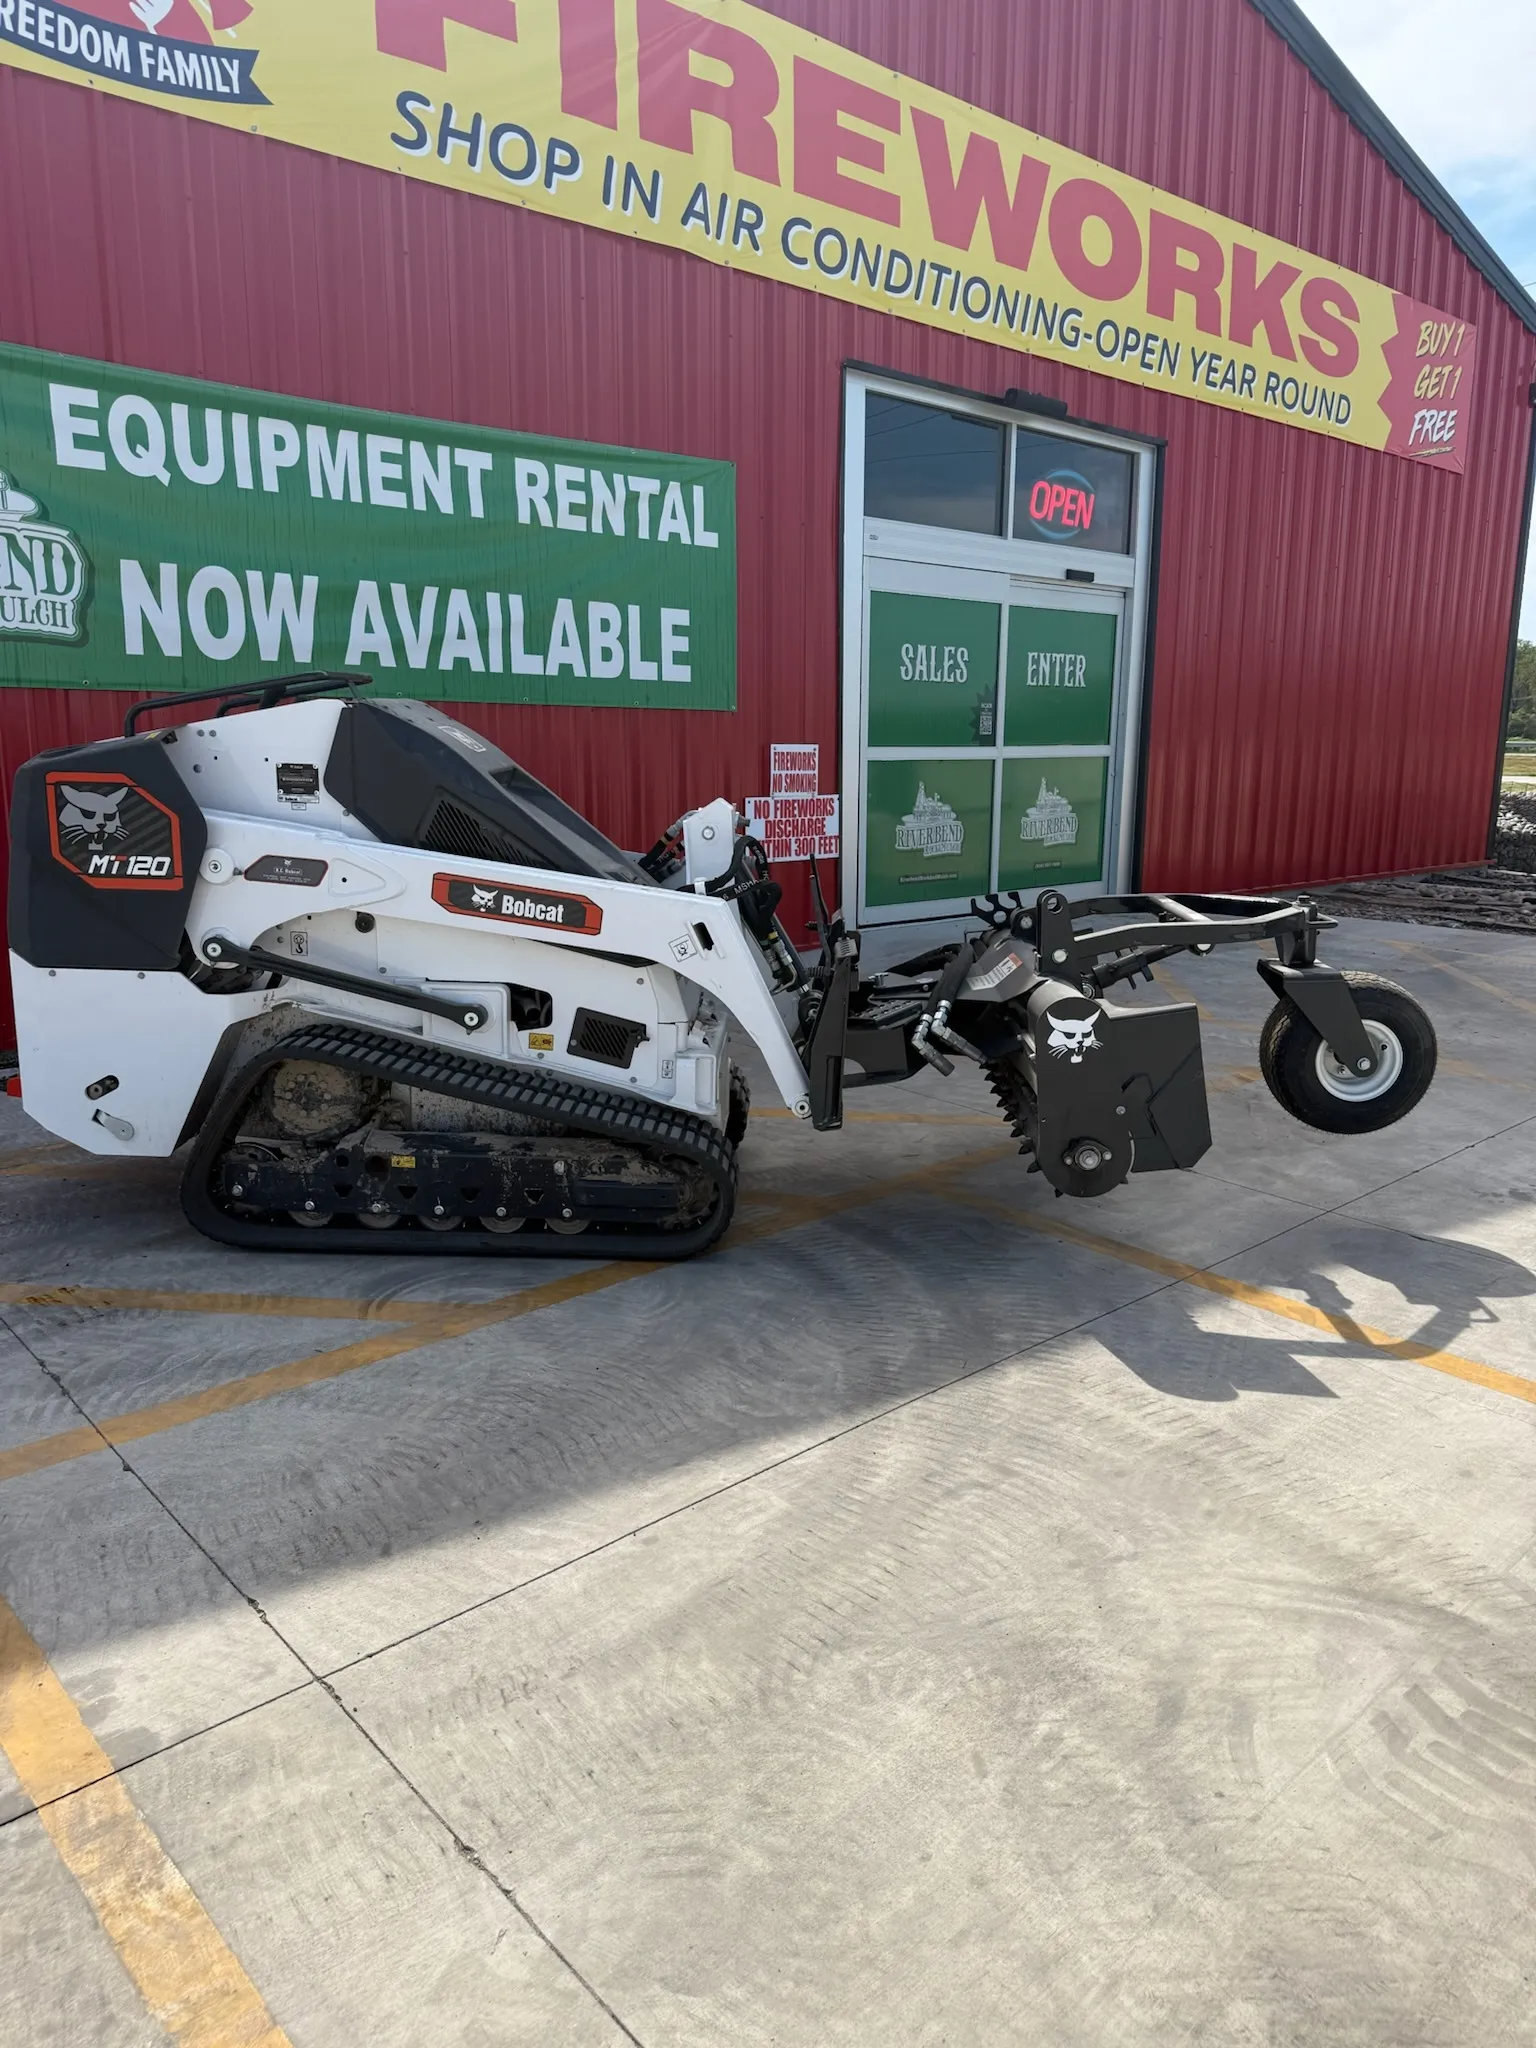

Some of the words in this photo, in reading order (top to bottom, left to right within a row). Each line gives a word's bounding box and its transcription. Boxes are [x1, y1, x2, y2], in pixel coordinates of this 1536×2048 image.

[139, 41, 240, 94] FAMILY
[390, 90, 582, 193] SHOP
[602, 155, 663, 220] IN
[681, 182, 765, 255] AIR
[1190, 347, 1257, 400] YEAR
[1265, 377, 1353, 427] ROUND
[1416, 320, 1456, 359] BUY
[1454, 323, 1466, 357] 1
[1414, 364, 1454, 400] GET
[1450, 366, 1463, 400] 1
[1408, 408, 1458, 446] FREE
[49, 383, 493, 519] EQUIPMENT
[514, 457, 719, 548] RENTAL
[1029, 480, 1096, 530] OPEN
[0, 533, 76, 596] ND
[120, 558, 319, 664] NOW
[344, 580, 692, 682] AVAILABLE
[900, 643, 969, 684] SALES
[1026, 651, 1087, 688] ENTER
[773, 751, 817, 771] FIREWORKS
[772, 773, 783, 793] NO
[784, 773, 817, 793] SMOKING
[754, 800, 770, 819] NO
[774, 797, 835, 819] FIREWORKS
[757, 839, 792, 858] THIN
[794, 837, 816, 856] 300
[818, 835, 839, 854] FEET
[765, 817, 826, 838] DISCHARGE
[501, 894, 564, 924] Bobcat
